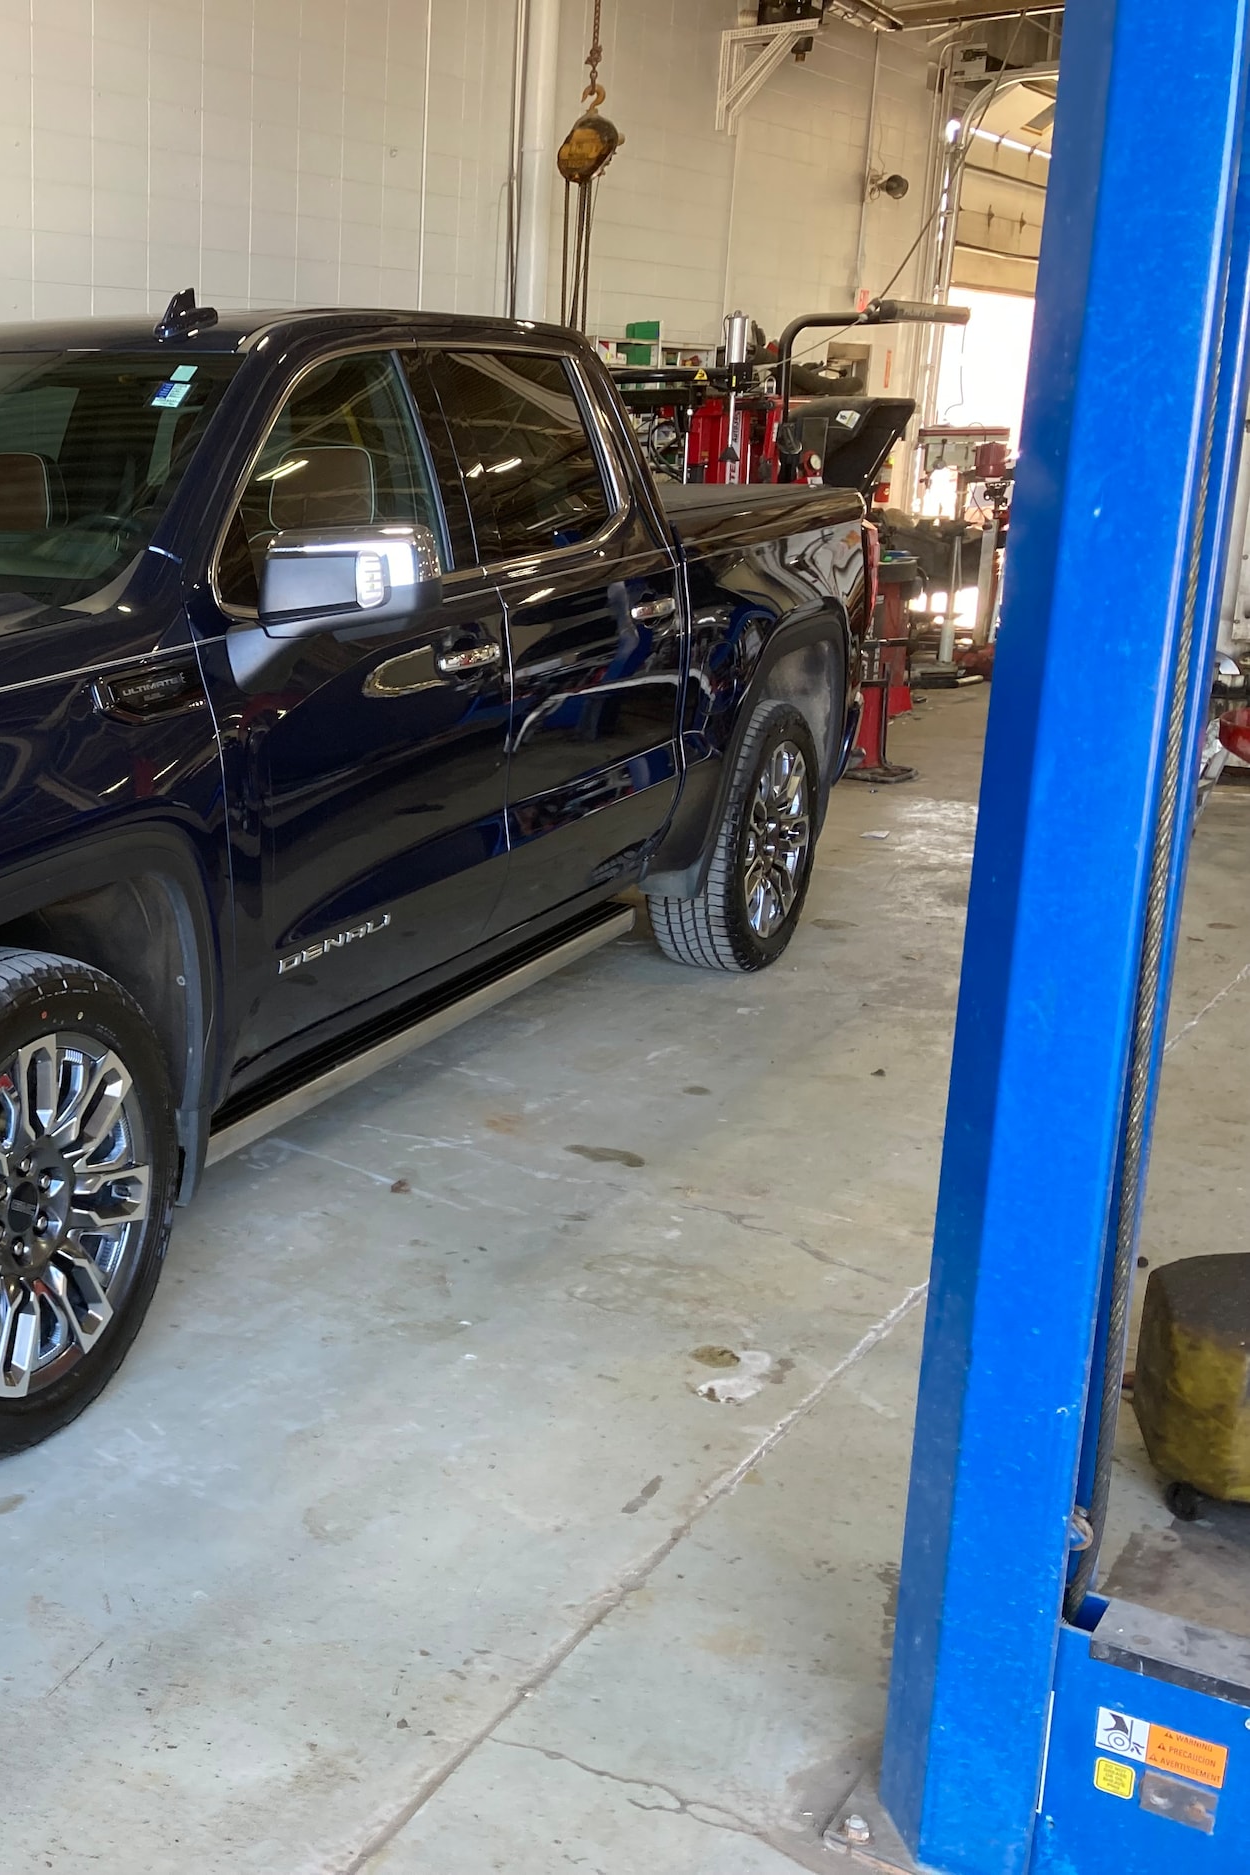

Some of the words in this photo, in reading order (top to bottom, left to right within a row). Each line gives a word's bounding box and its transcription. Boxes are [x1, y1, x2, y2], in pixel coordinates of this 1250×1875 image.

[122, 678, 178, 697] ULTIMATE
[278, 912, 391, 975] DENALI
[1175, 1733, 1214, 1753] WARNING
[1160, 1757, 1222, 1783] AVERTISSEMENT
